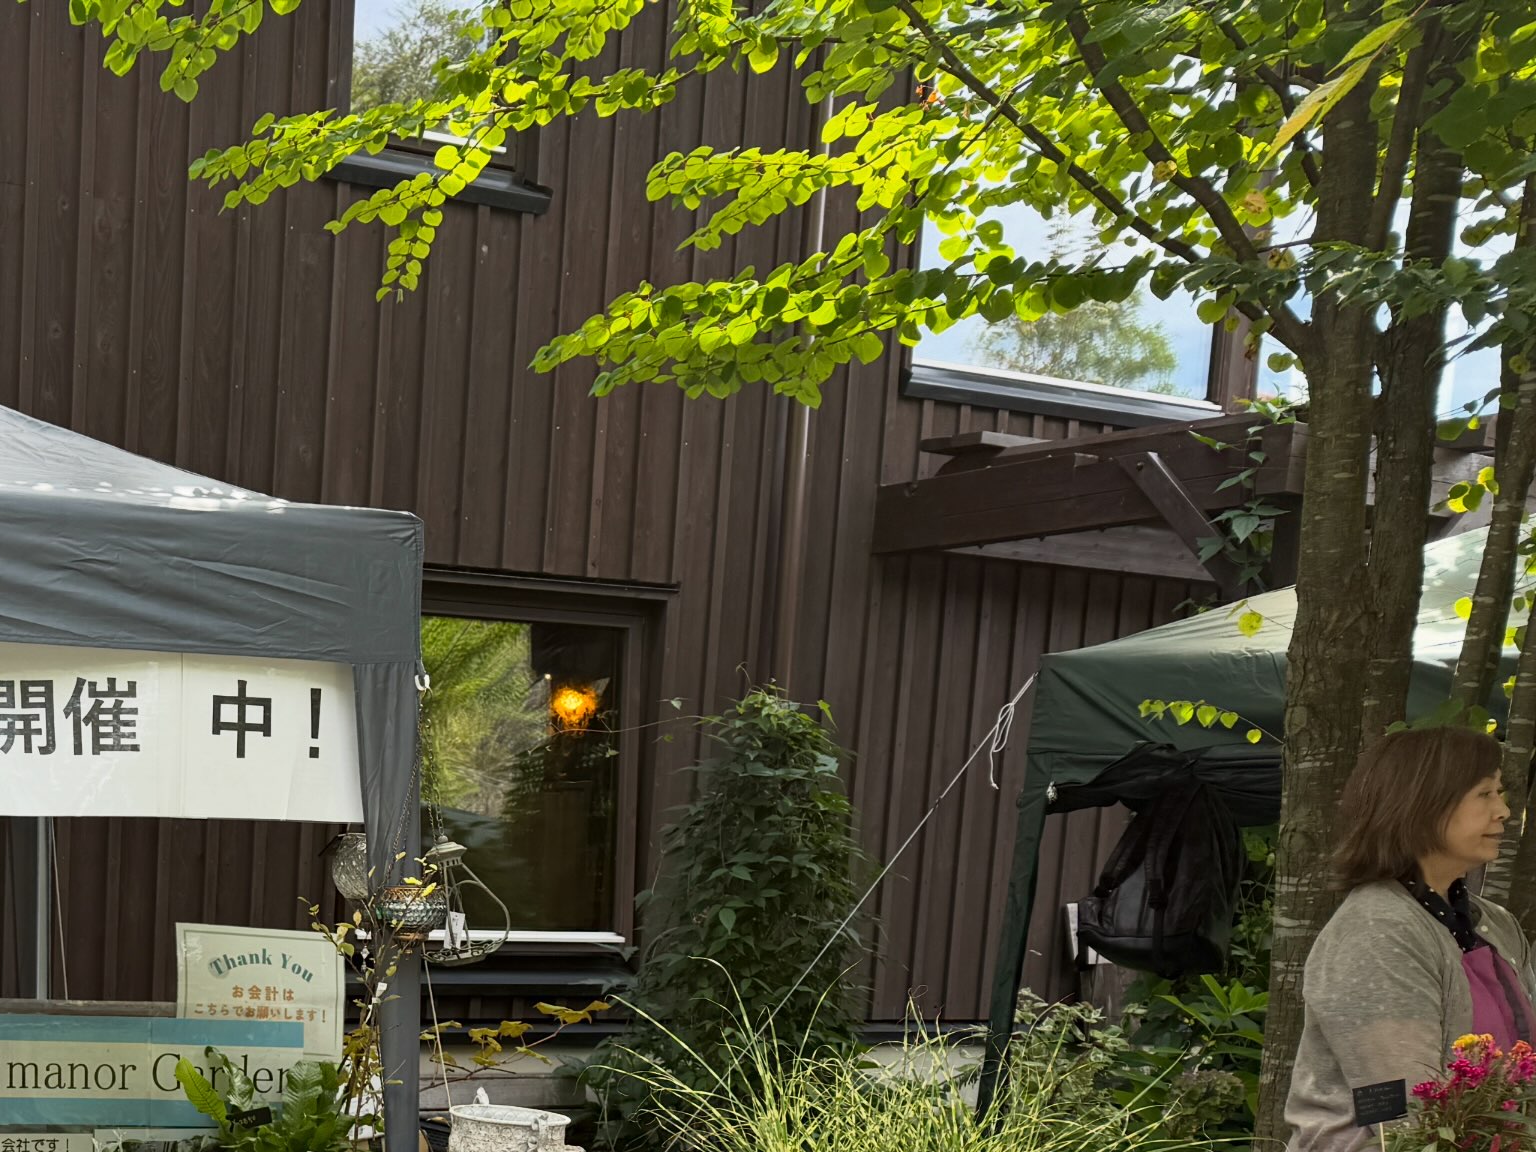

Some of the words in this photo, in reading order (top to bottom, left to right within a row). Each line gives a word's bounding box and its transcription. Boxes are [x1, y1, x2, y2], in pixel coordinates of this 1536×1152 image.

[209, 948, 272, 976] Thank
[282, 953, 314, 983] You
[232, 985, 294, 1001] お会計は
[6, 1058, 136, 1091] manor
